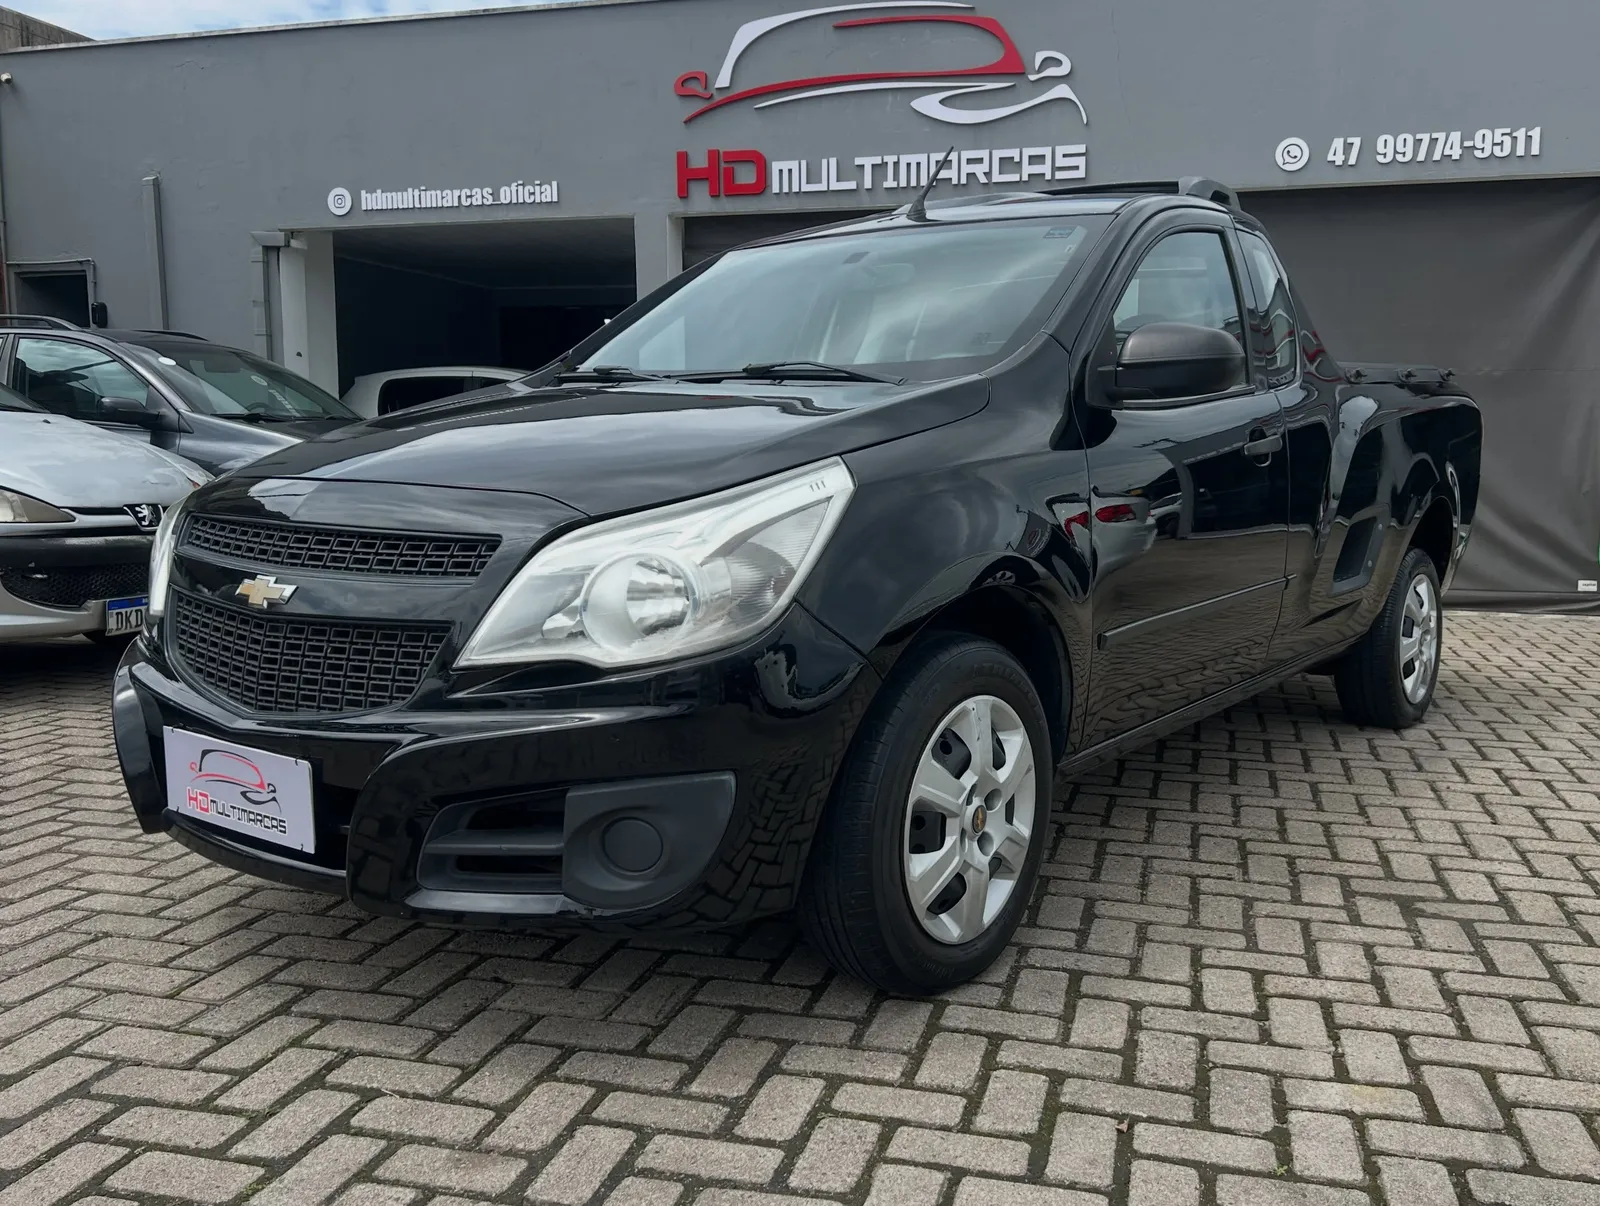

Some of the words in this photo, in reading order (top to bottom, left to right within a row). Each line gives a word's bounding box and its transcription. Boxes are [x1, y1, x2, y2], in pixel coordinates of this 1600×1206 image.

[1327, 137, 1361, 166] 47
[1376, 126, 1541, 164] 99774-9511
[361, 180, 558, 211] hdmultimarcas_oficial
[115, 608, 143, 630] DKD
